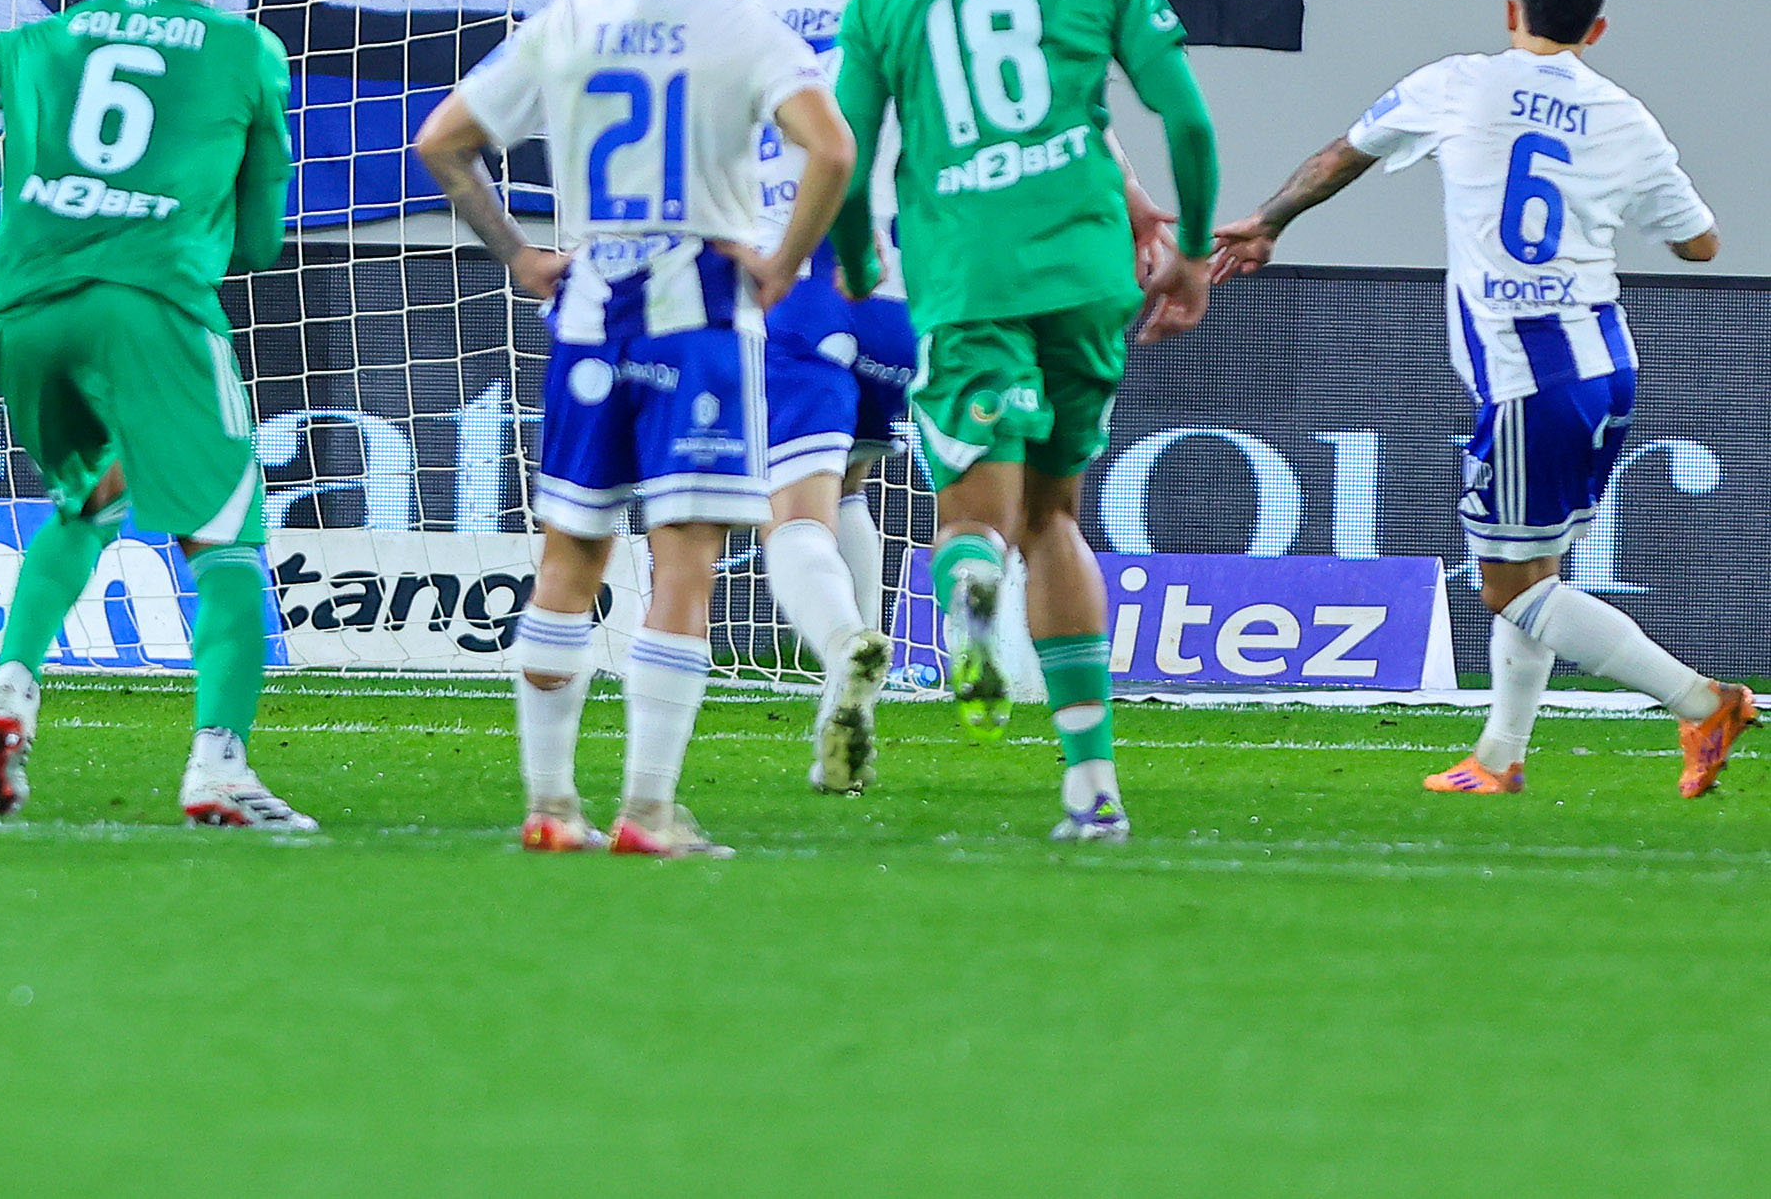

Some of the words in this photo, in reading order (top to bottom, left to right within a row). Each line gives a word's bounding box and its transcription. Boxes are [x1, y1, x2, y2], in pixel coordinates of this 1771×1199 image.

[66, 10, 207, 51] GOLDSON
[595, 21, 687, 54] T.KISS
[69, 43, 167, 175] 6
[1510, 89, 1588, 135] SENSI
[586, 67, 689, 221] 21
[1500, 131, 1573, 265] 6
[1484, 271, 1579, 303] IronFX
